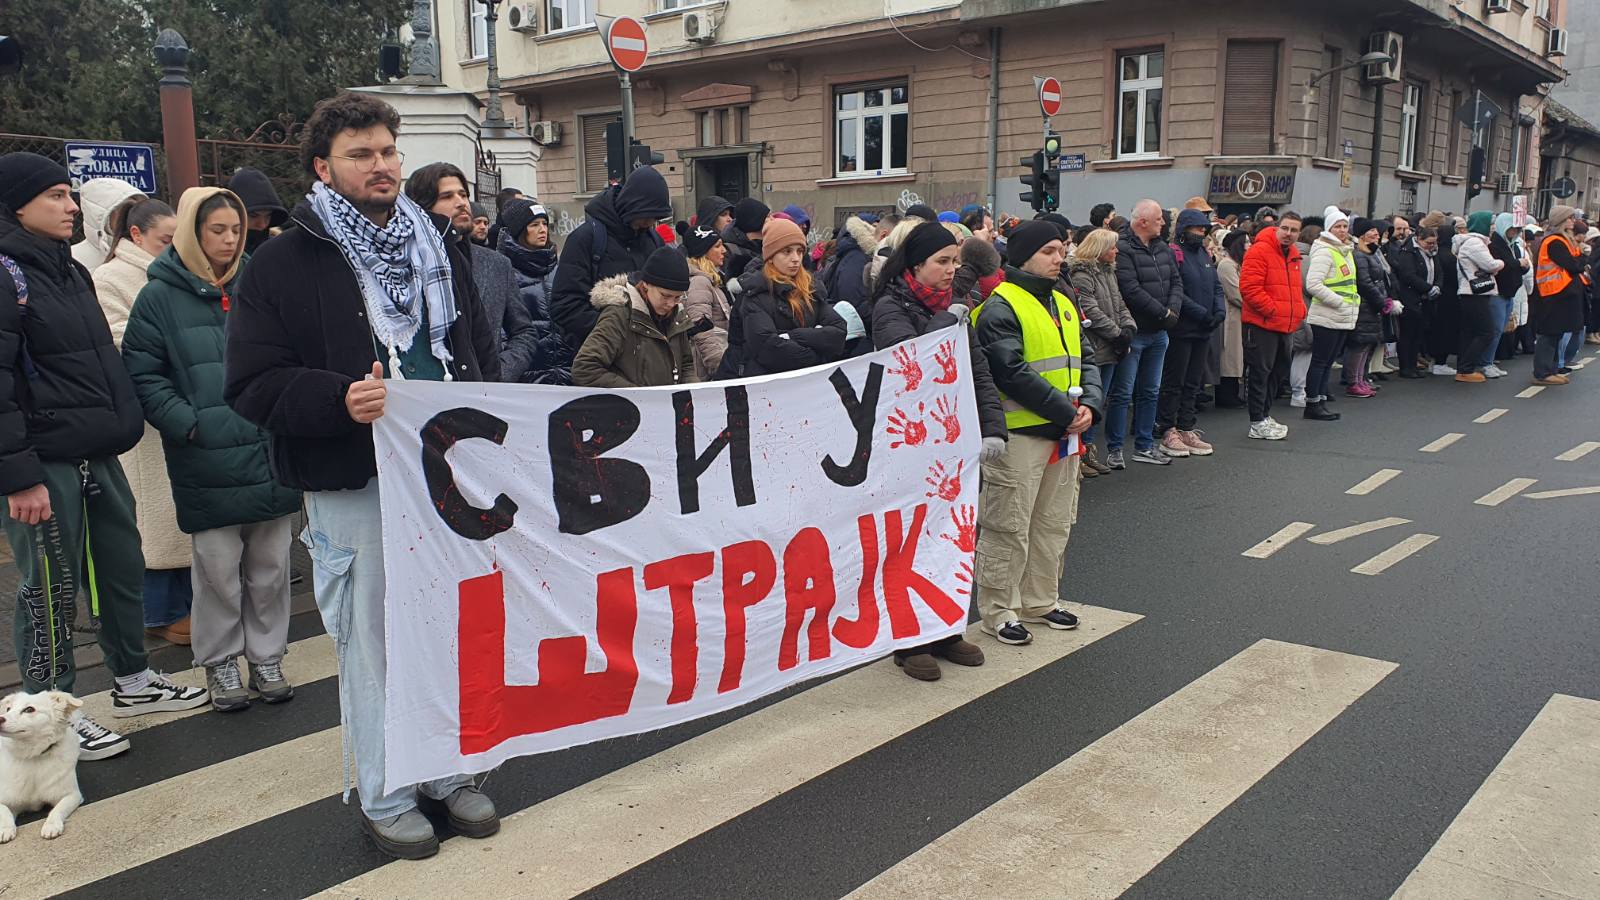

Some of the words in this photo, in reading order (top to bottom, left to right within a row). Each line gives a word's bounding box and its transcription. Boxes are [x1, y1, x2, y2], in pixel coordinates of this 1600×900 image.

[91, 148, 128, 158] УЛИЦА
[87, 160, 137, 174] ЈОВАНА
[1210, 176, 1237, 193] BEER
[1265, 176, 1292, 193] SHOP
[420, 385, 756, 540] СВИ
[821, 362, 884, 487] У
[458, 503, 965, 755] ШТРАЈК
